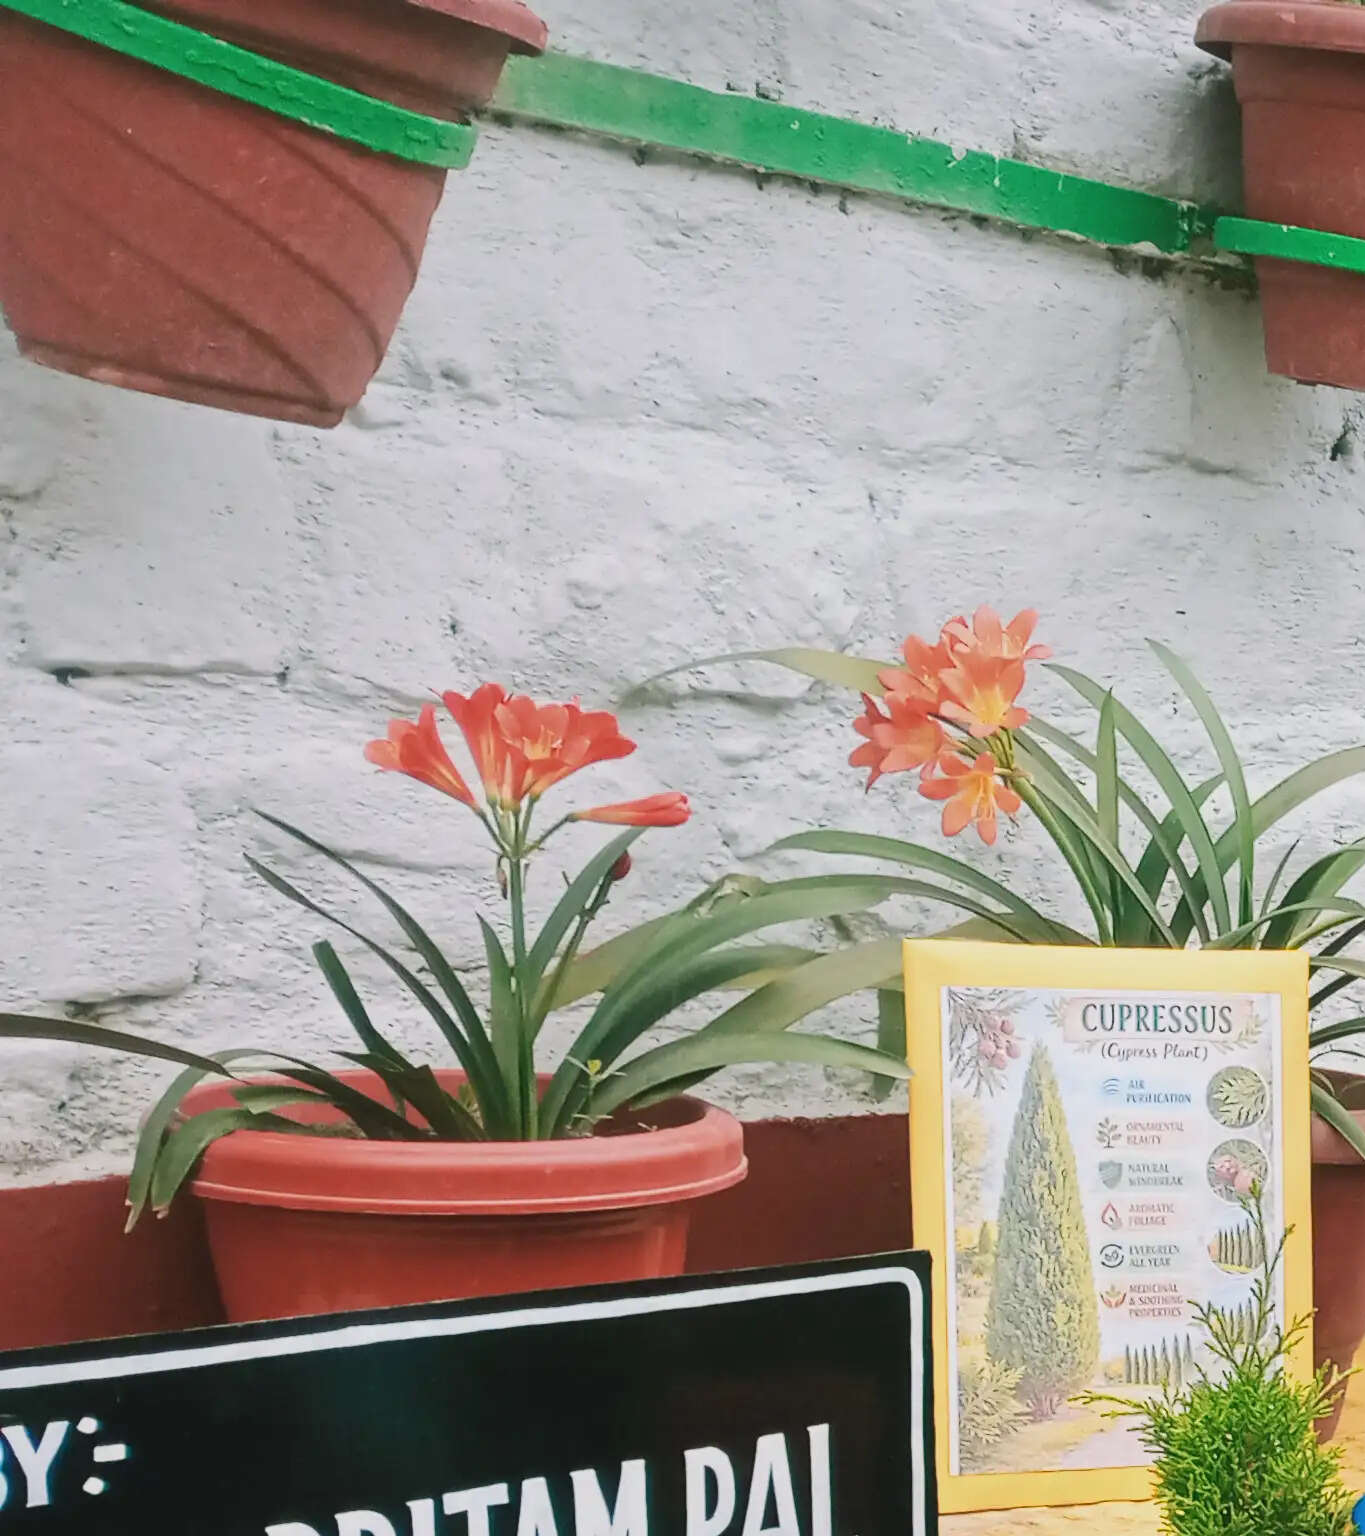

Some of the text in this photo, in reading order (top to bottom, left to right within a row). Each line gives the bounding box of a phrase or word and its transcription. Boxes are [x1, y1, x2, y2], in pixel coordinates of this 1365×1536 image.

[1081, 1003, 1233, 1034] CUPRESSUS
[1101, 1041, 1208, 1062] (Cypress Plant)
[0, 1417, 127, 1511] Y:-
